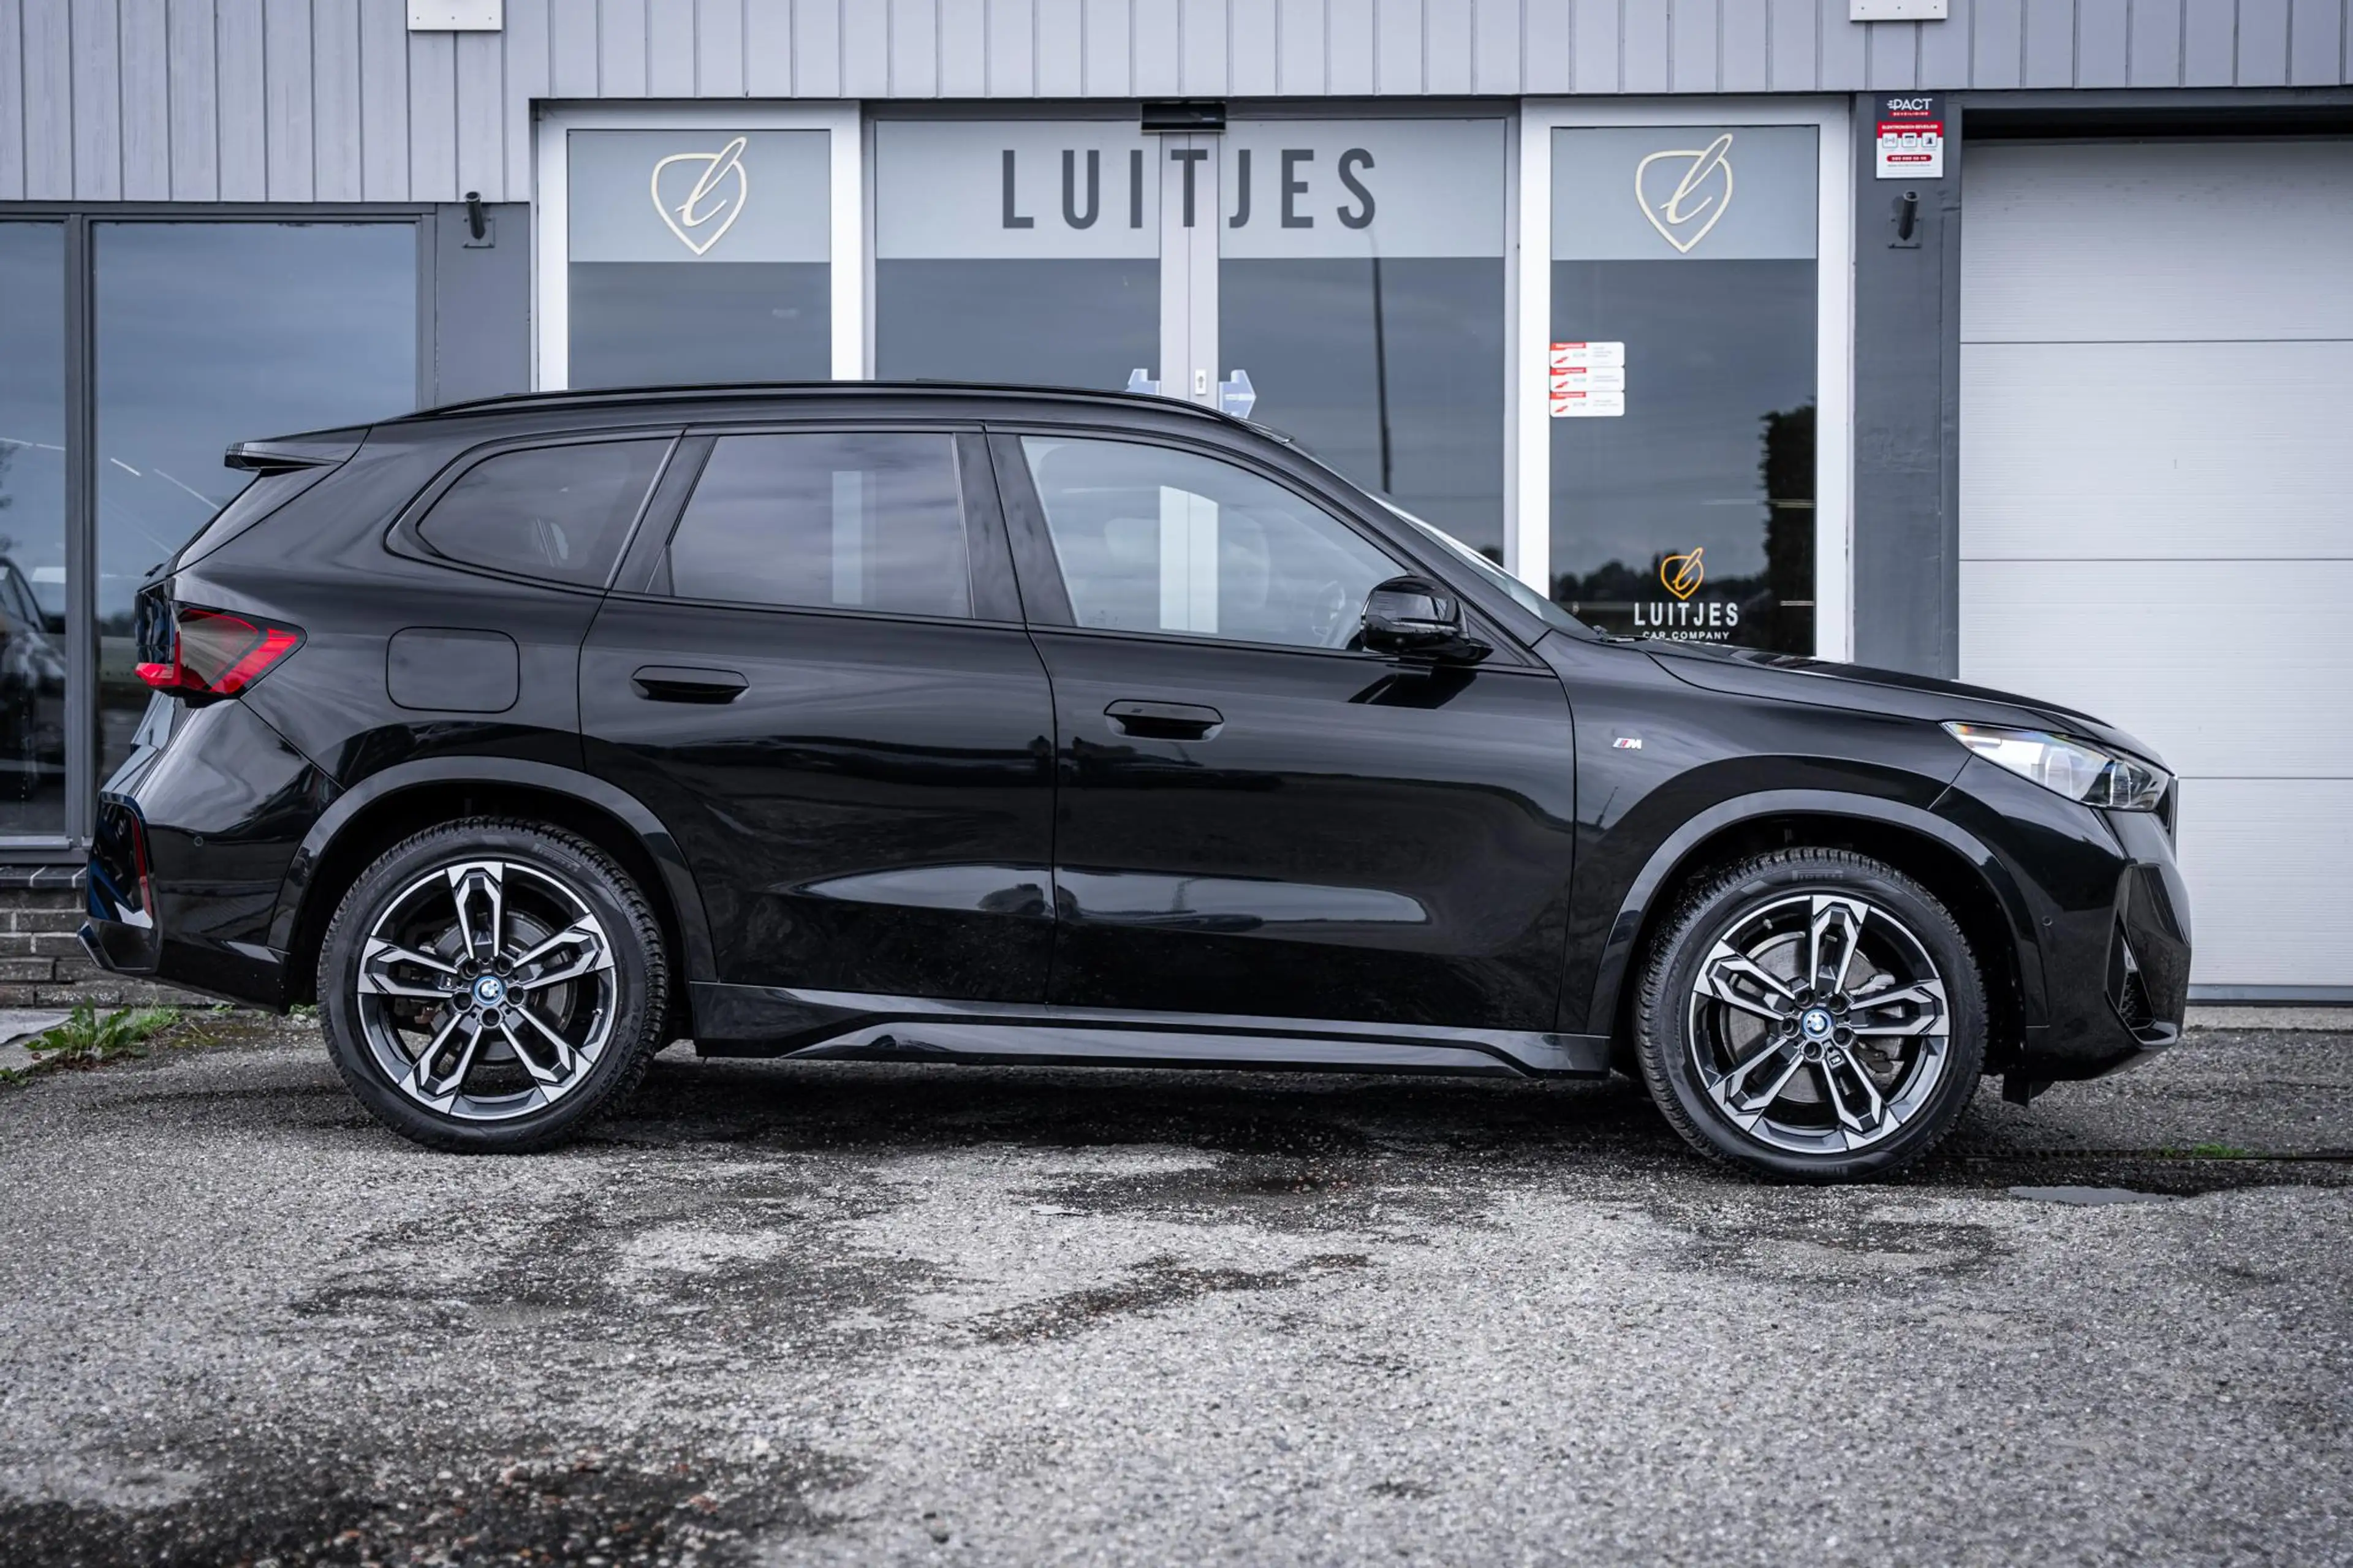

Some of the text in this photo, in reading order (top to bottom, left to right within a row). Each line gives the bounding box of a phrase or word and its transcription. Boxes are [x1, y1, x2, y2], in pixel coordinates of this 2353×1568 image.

[1890, 98, 1933, 110] PACT
[1002, 148, 1376, 230] LUITJES
[1634, 602, 1739, 627] LUITJES
[1671, 631, 1730, 640] COMPANY
